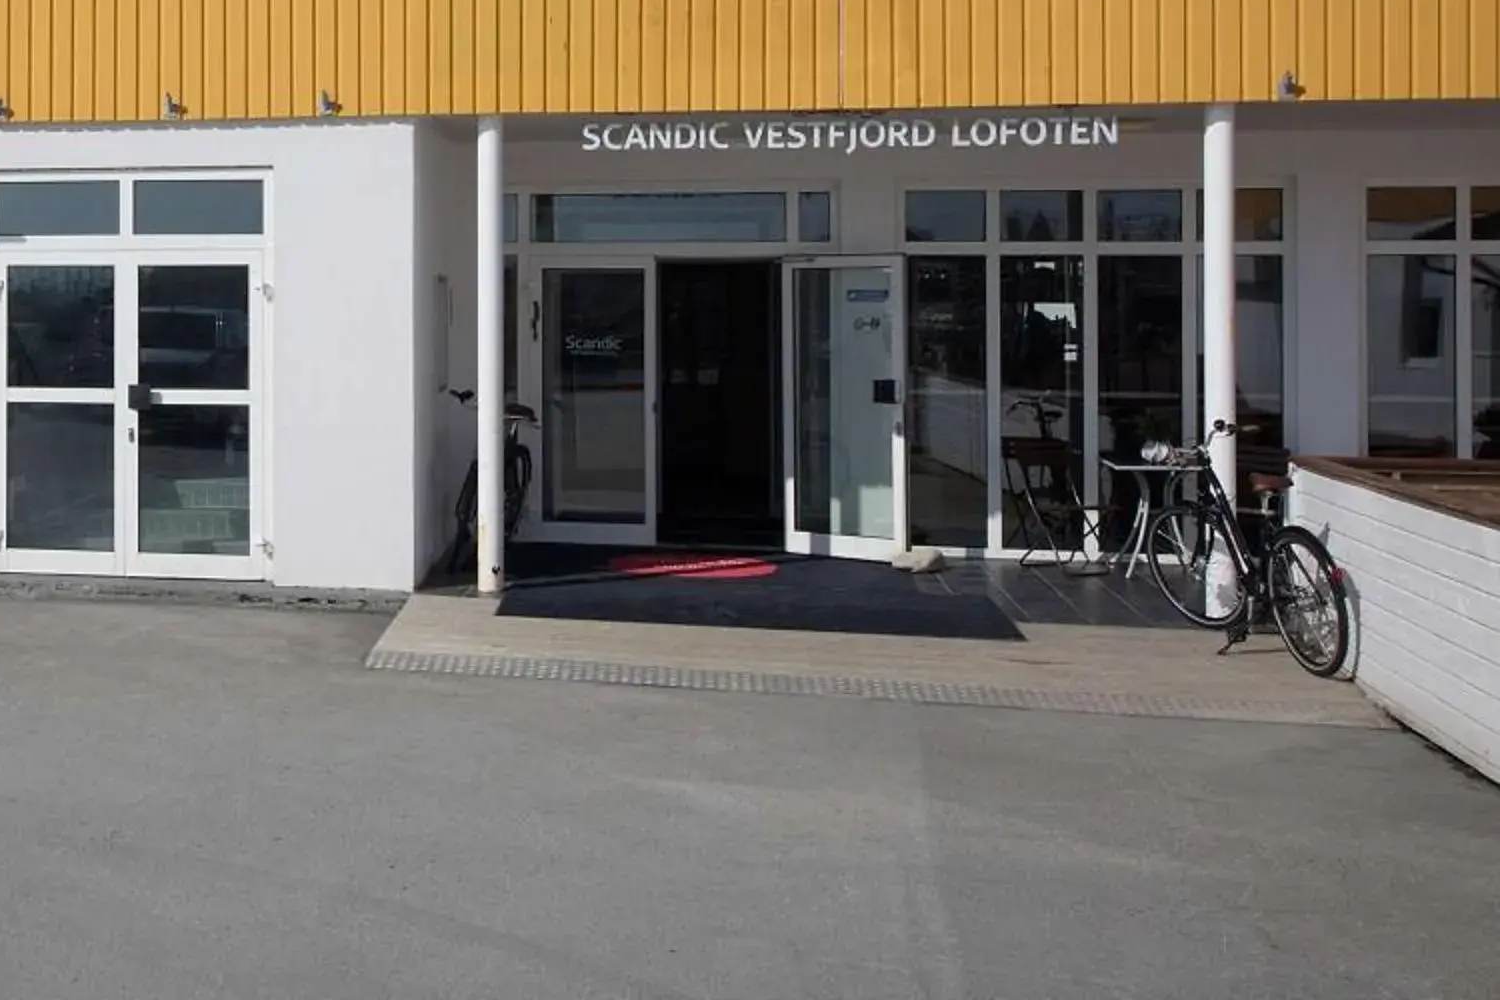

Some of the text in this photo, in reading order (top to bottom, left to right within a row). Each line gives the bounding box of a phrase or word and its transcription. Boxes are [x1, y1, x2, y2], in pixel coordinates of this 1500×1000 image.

[581, 116, 1119, 155] SCANDIC VESTFJORD LOFOTEN
